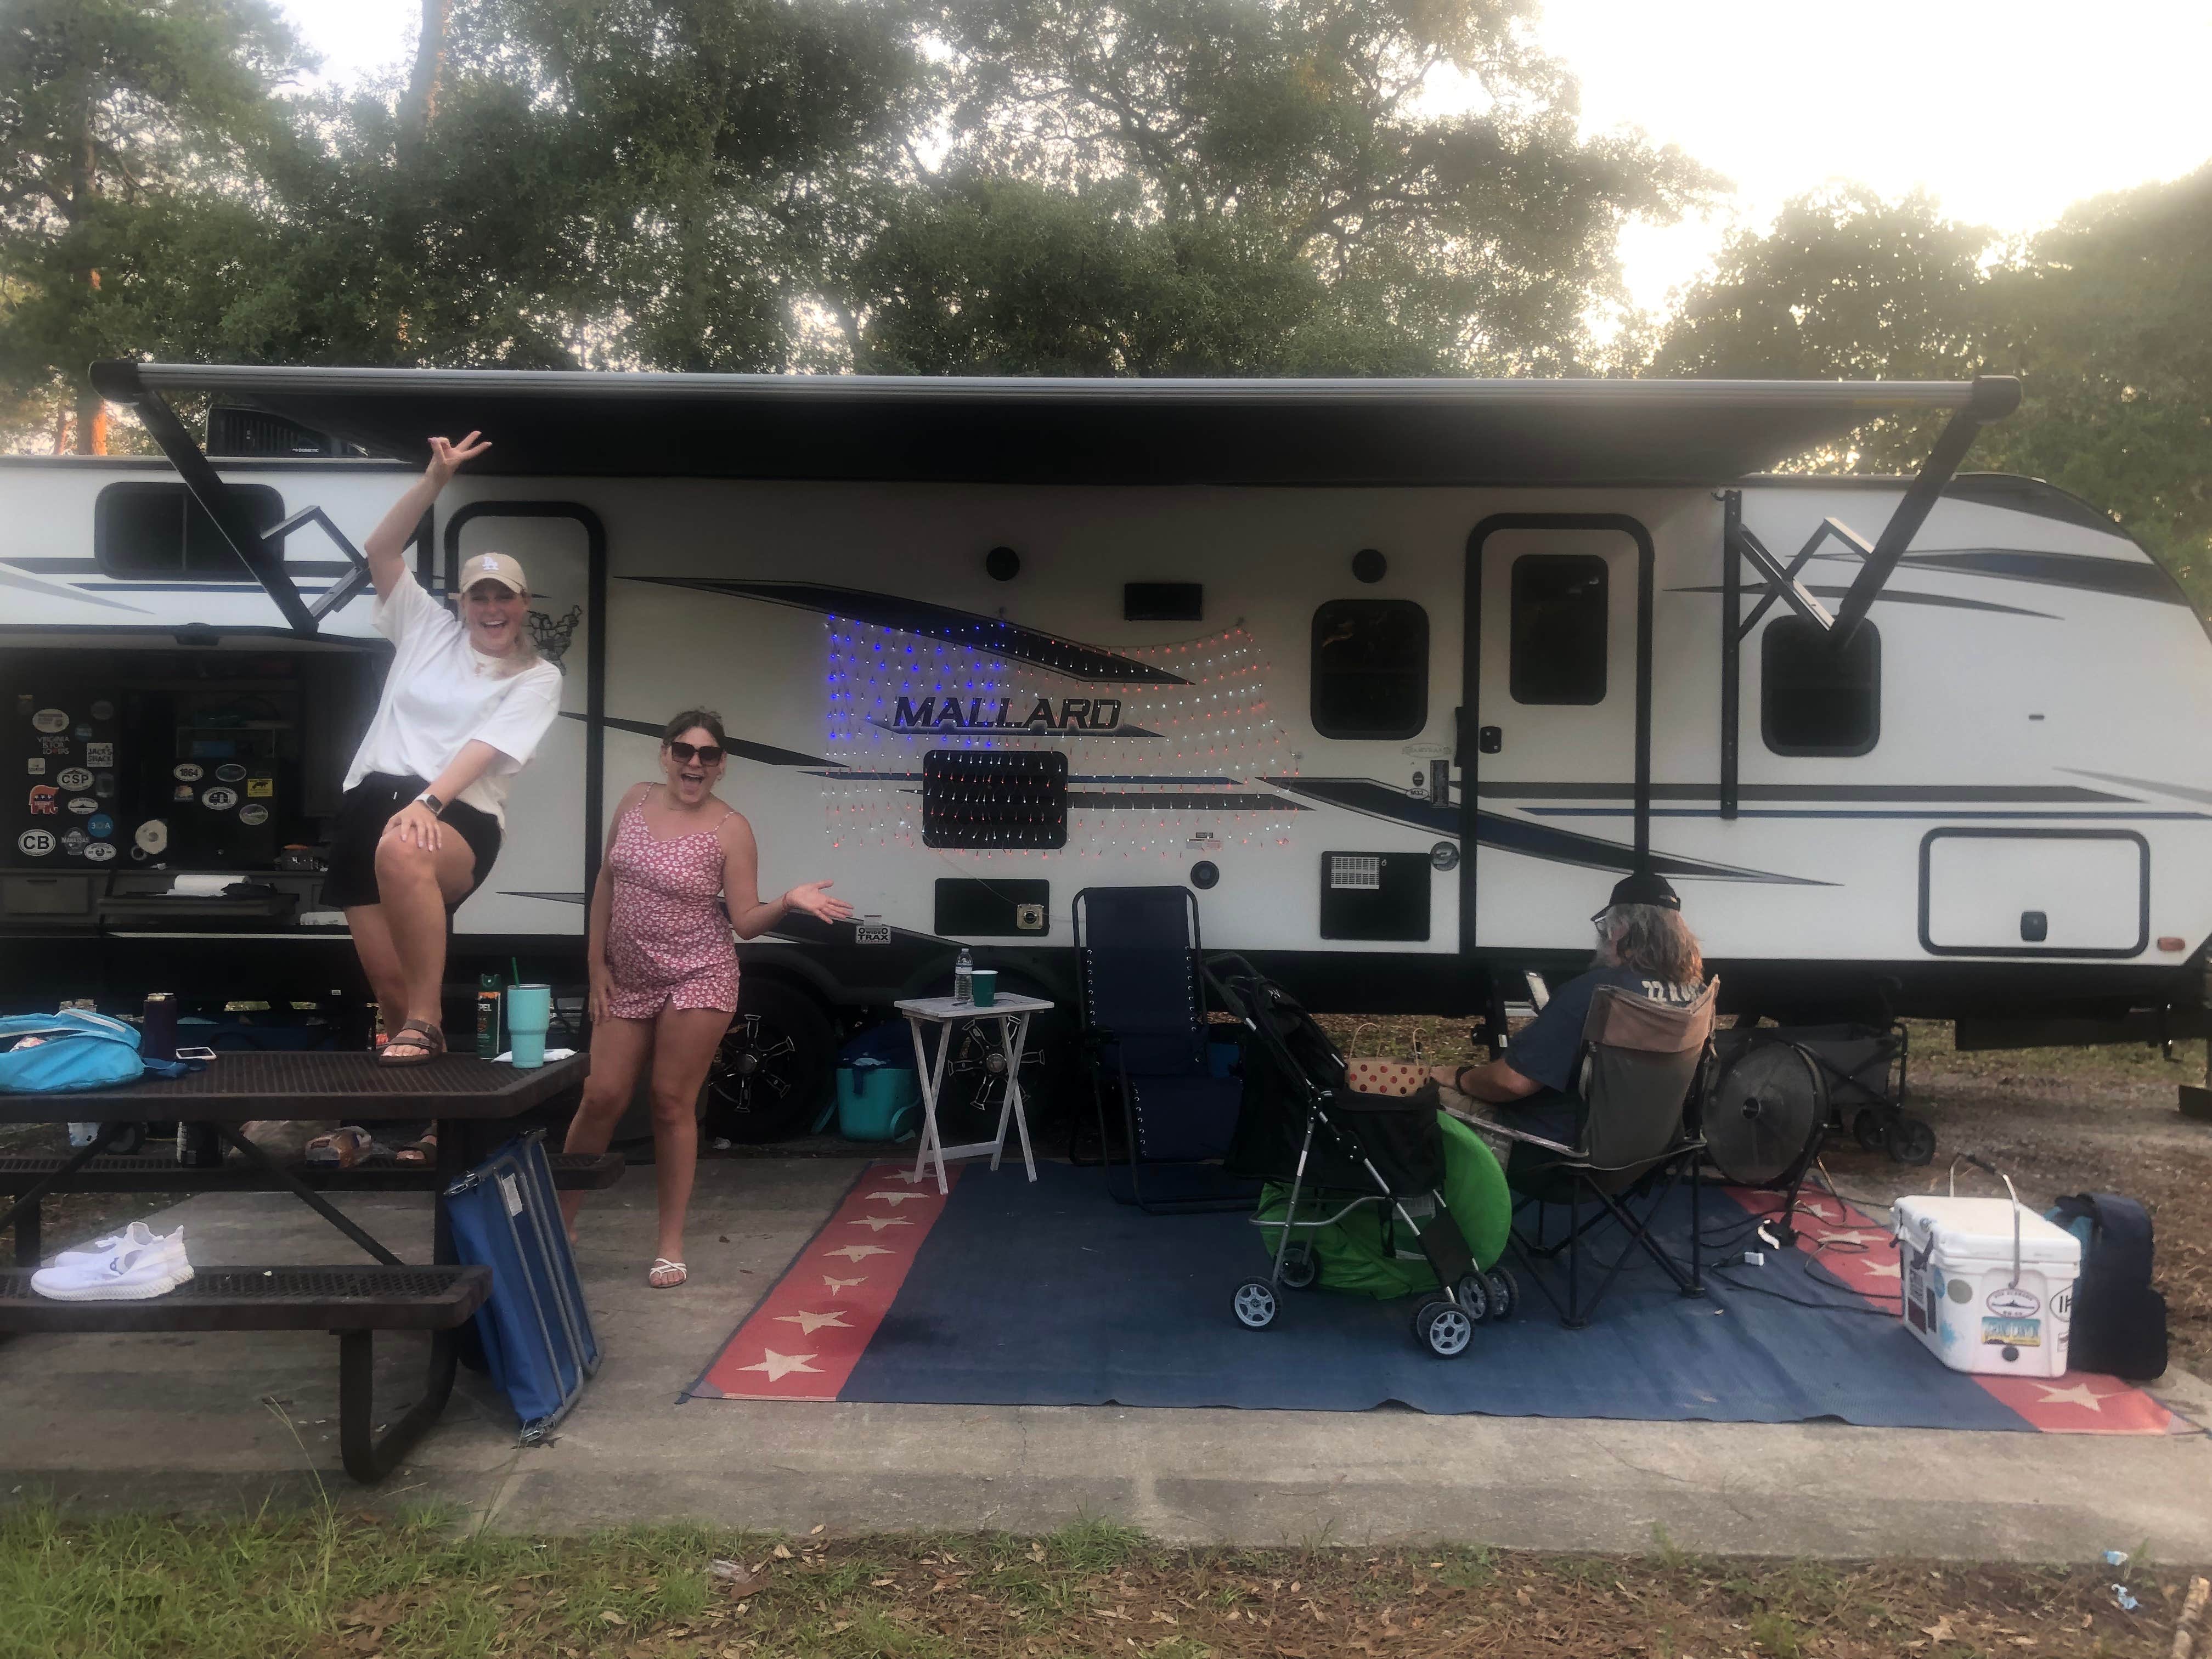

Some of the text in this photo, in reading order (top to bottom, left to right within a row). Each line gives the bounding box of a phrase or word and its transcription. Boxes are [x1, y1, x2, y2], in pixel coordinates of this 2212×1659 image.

[893, 696, 1121, 730] MALLARD
[179, 768, 198, 777] 1864
[61, 775, 89, 784] CSP
[23, 835, 50, 850] CB
